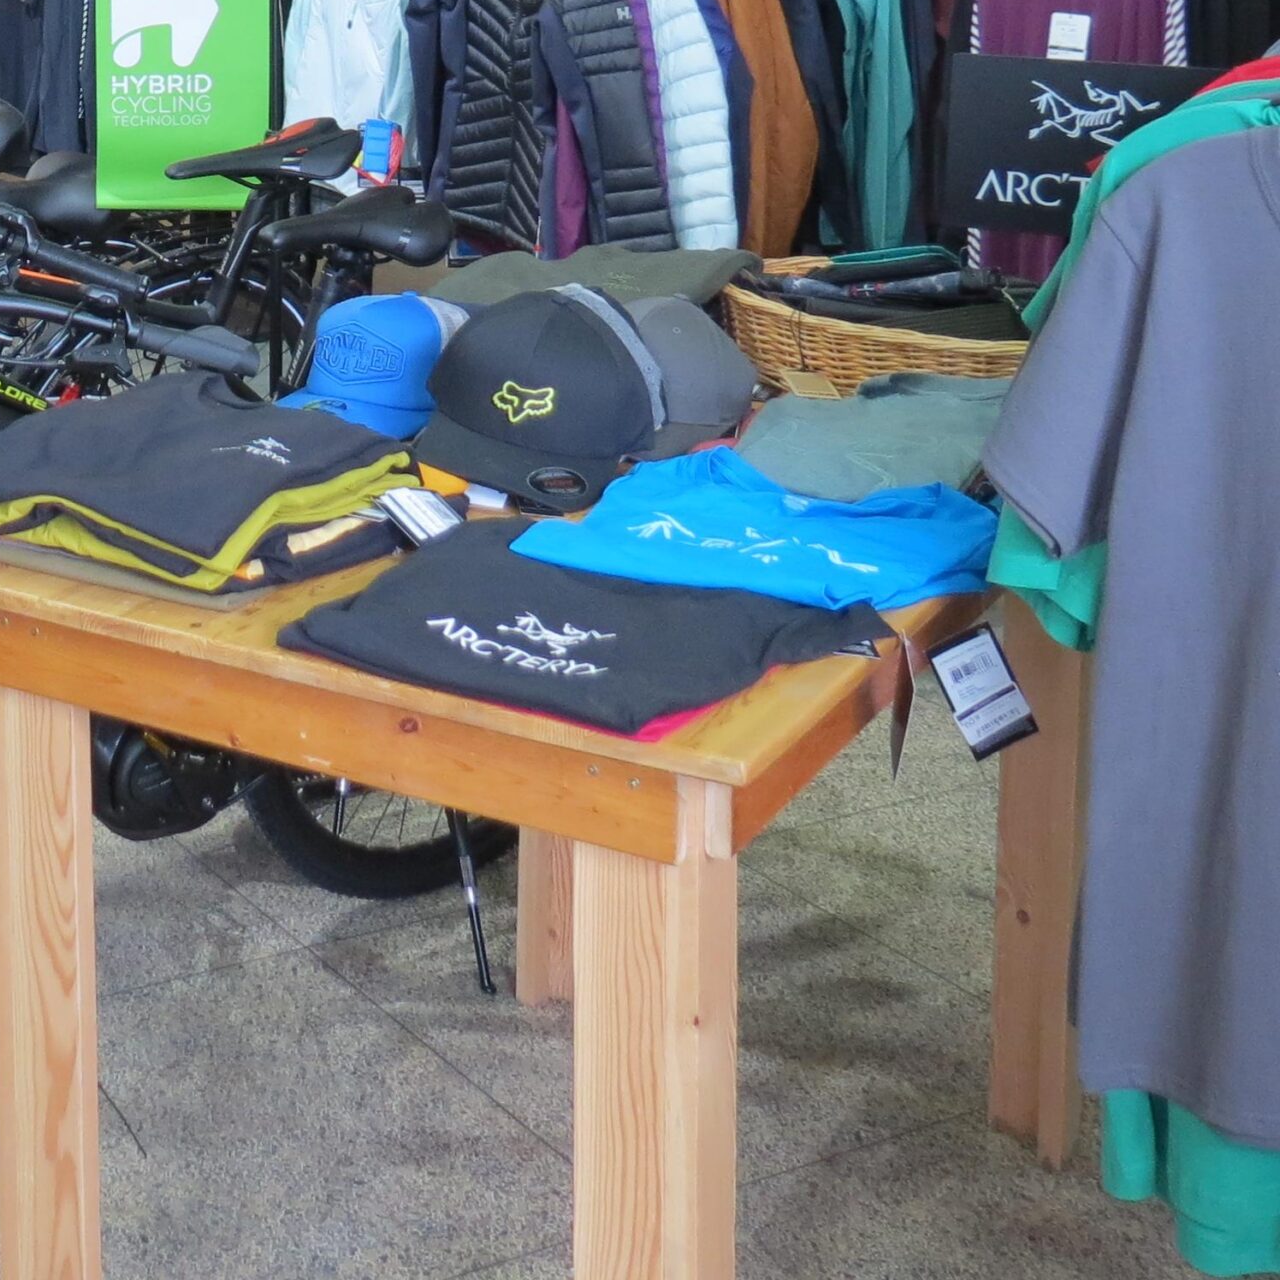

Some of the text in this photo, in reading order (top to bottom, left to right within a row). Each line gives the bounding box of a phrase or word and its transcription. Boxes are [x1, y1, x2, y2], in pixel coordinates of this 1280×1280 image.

[111, 74, 212, 94] HYBRID
[111, 95, 212, 113] CYCLING
[113, 114, 211, 127] TECHNOLOGY
